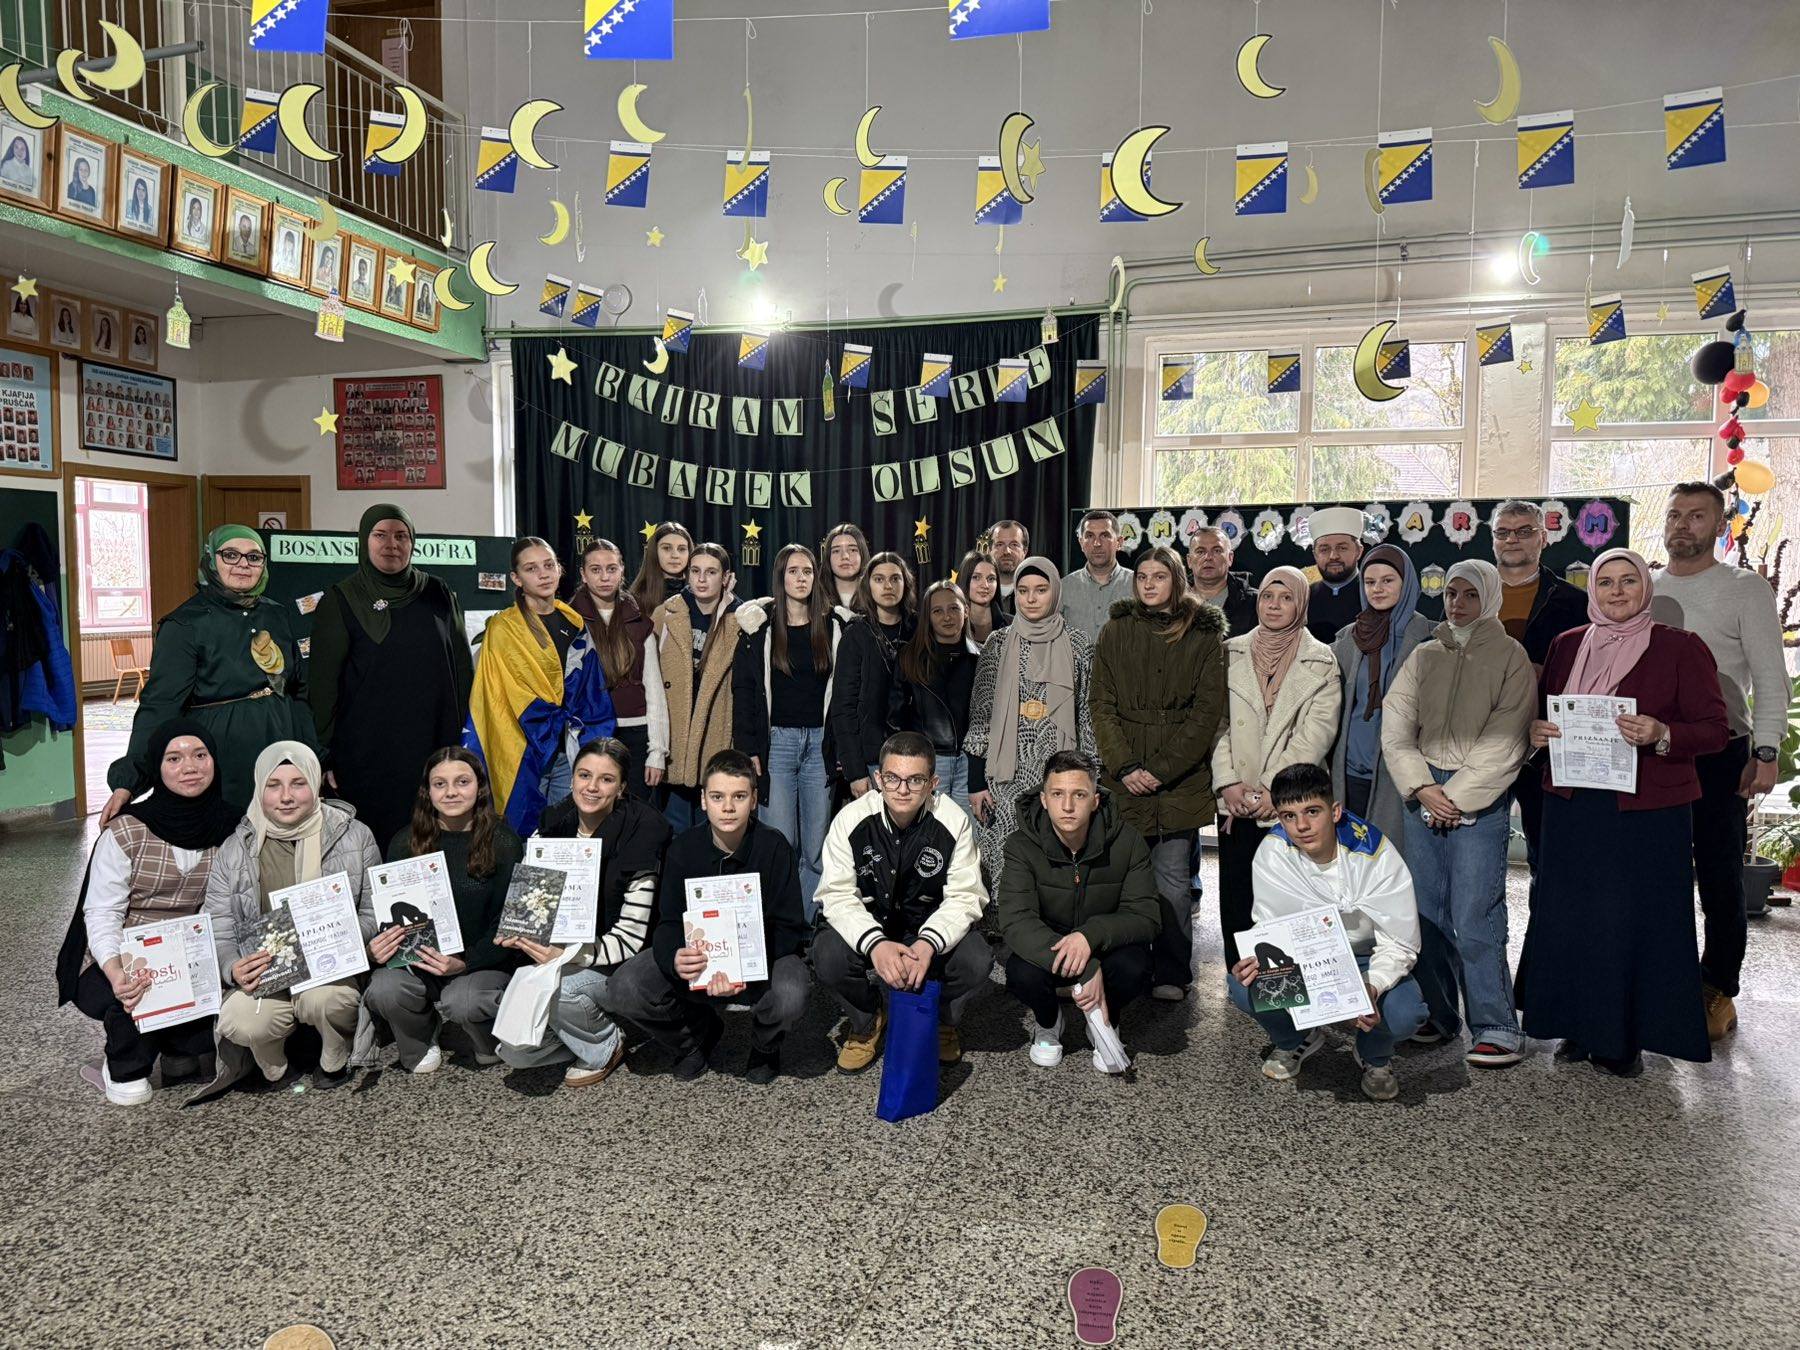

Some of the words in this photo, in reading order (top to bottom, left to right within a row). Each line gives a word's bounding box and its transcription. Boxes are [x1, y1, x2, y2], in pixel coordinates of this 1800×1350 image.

[2, 388, 35, 400] KJAFIJA
[598, 364, 803, 434] BAJRAM
[554, 424, 812, 507] MUBAREK
[874, 420, 1064, 500] OLSUN
[1121, 516, 1310, 541] AMADA
[1365, 511, 1609, 534] KAREM
[279, 540, 358, 557] BOSANS
[412, 542, 473, 559] SOFRA
[301, 920, 342, 937] IPLOMA
[694, 938, 729, 953] Post
[1302, 957, 1338, 971] PLOMA
